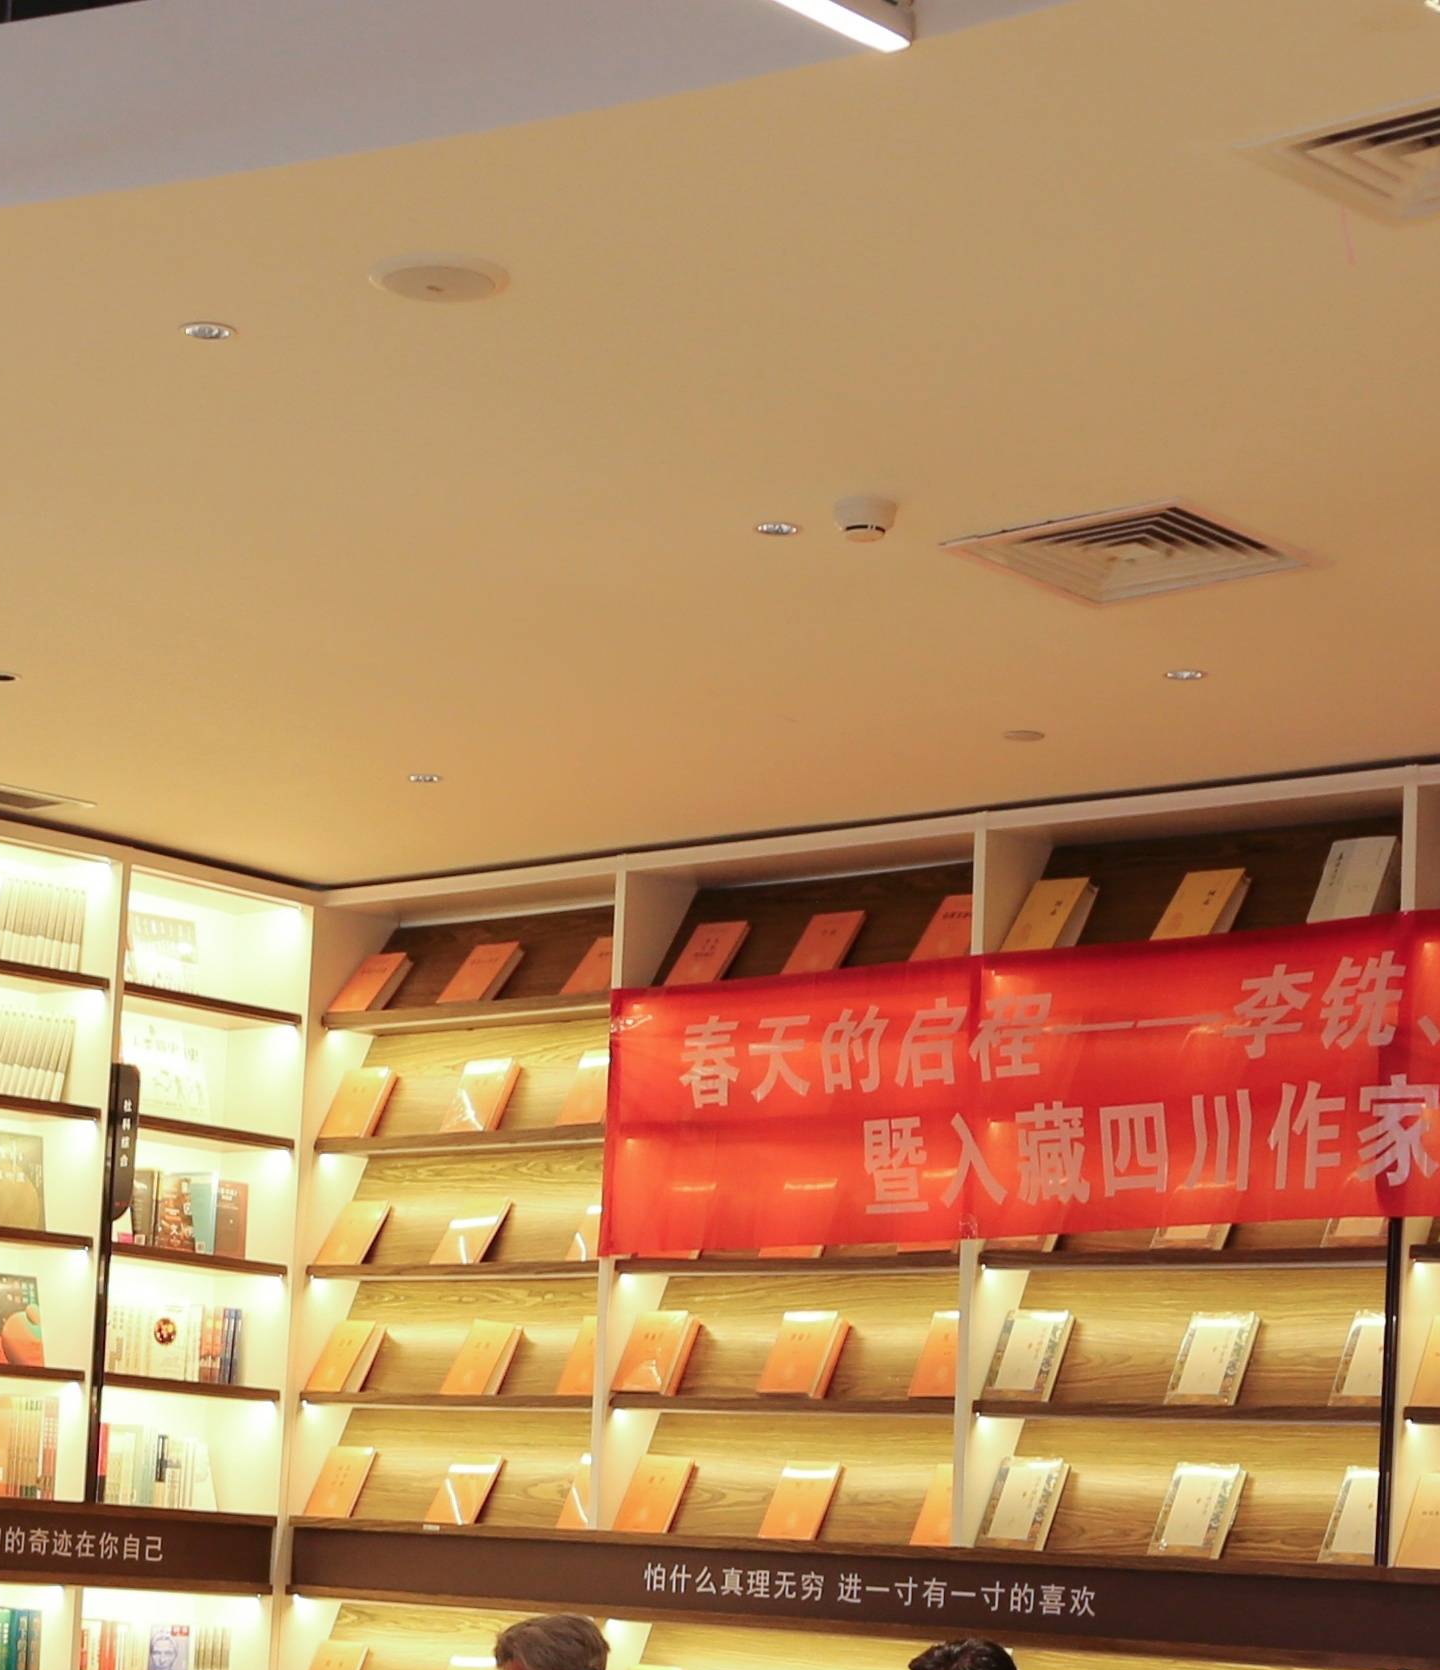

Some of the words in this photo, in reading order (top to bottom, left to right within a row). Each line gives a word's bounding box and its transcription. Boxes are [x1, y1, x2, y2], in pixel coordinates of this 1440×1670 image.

[643, 1562, 826, 1604] 怕什么真理无穷
[836, 1572, 1098, 1620] 进一寸有一寸的喜欢
